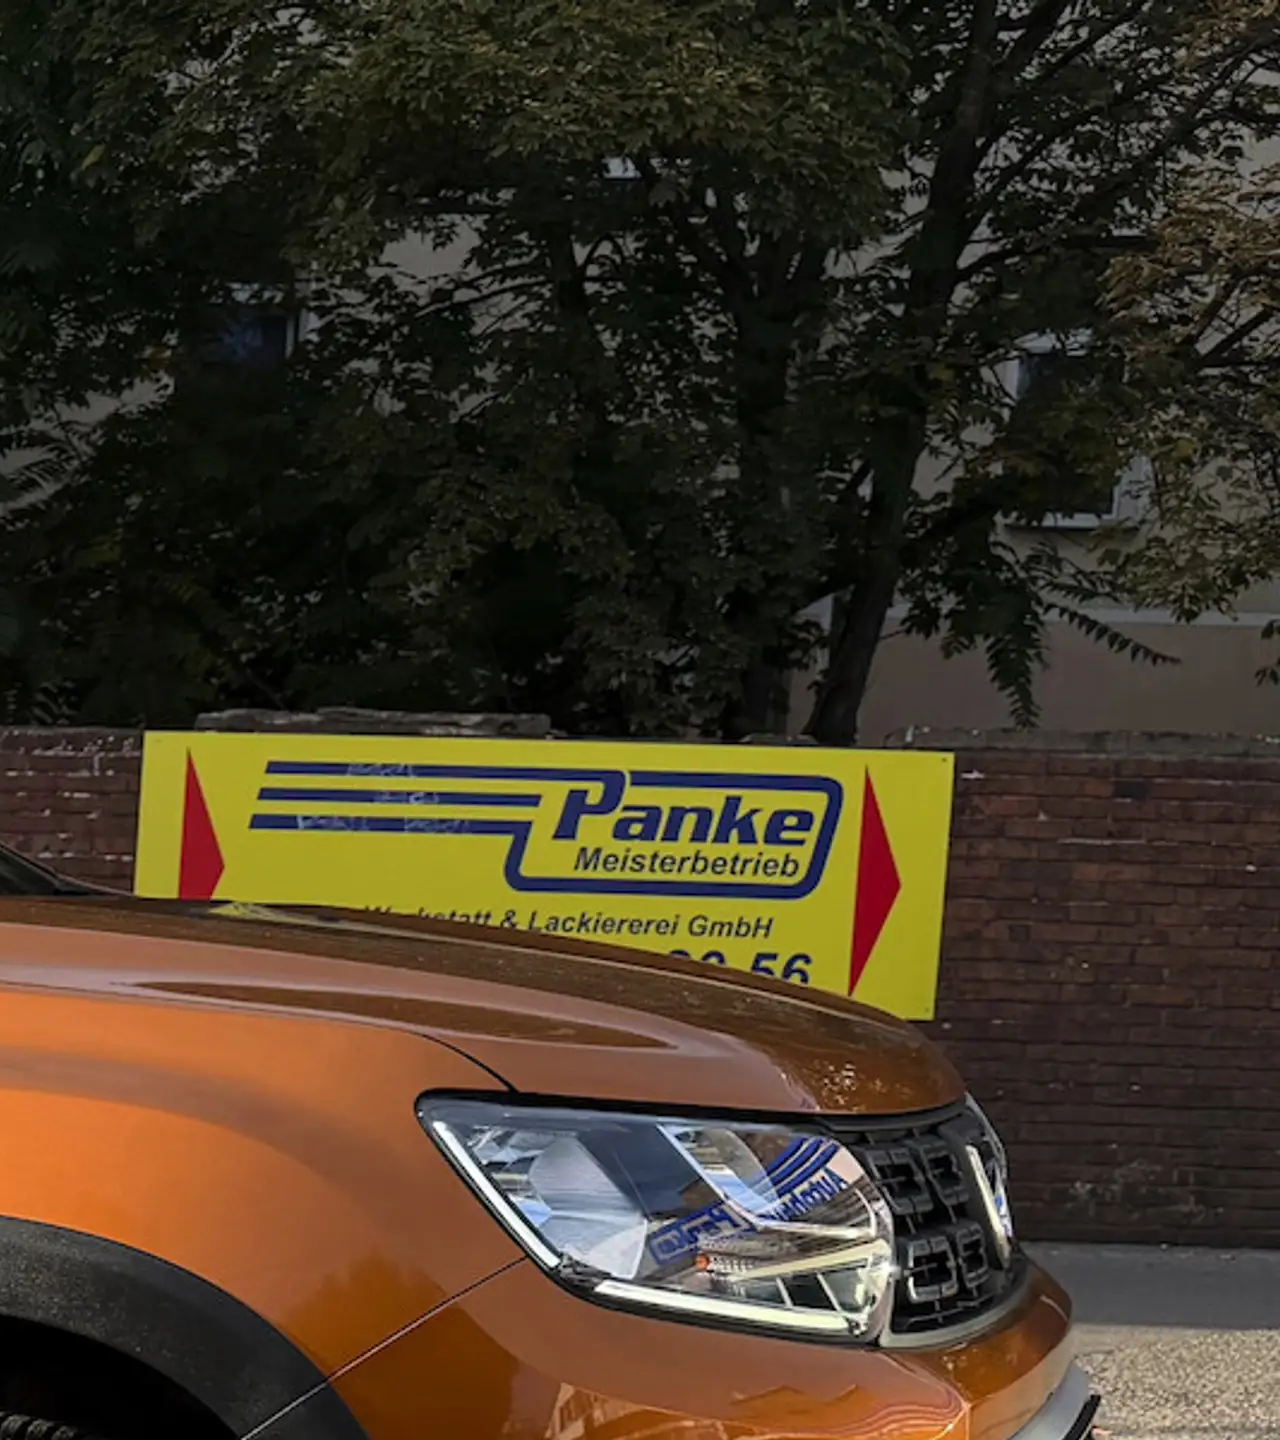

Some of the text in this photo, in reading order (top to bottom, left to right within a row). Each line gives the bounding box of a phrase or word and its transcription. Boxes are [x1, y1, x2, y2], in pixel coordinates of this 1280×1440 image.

[552, 769, 815, 846] Panke
[574, 846, 800, 878] Meisterbetrieb
[500, 908, 517, 930] &
[528, 910, 681, 937] Lackiererei
[687, 914, 774, 939] GmbH
